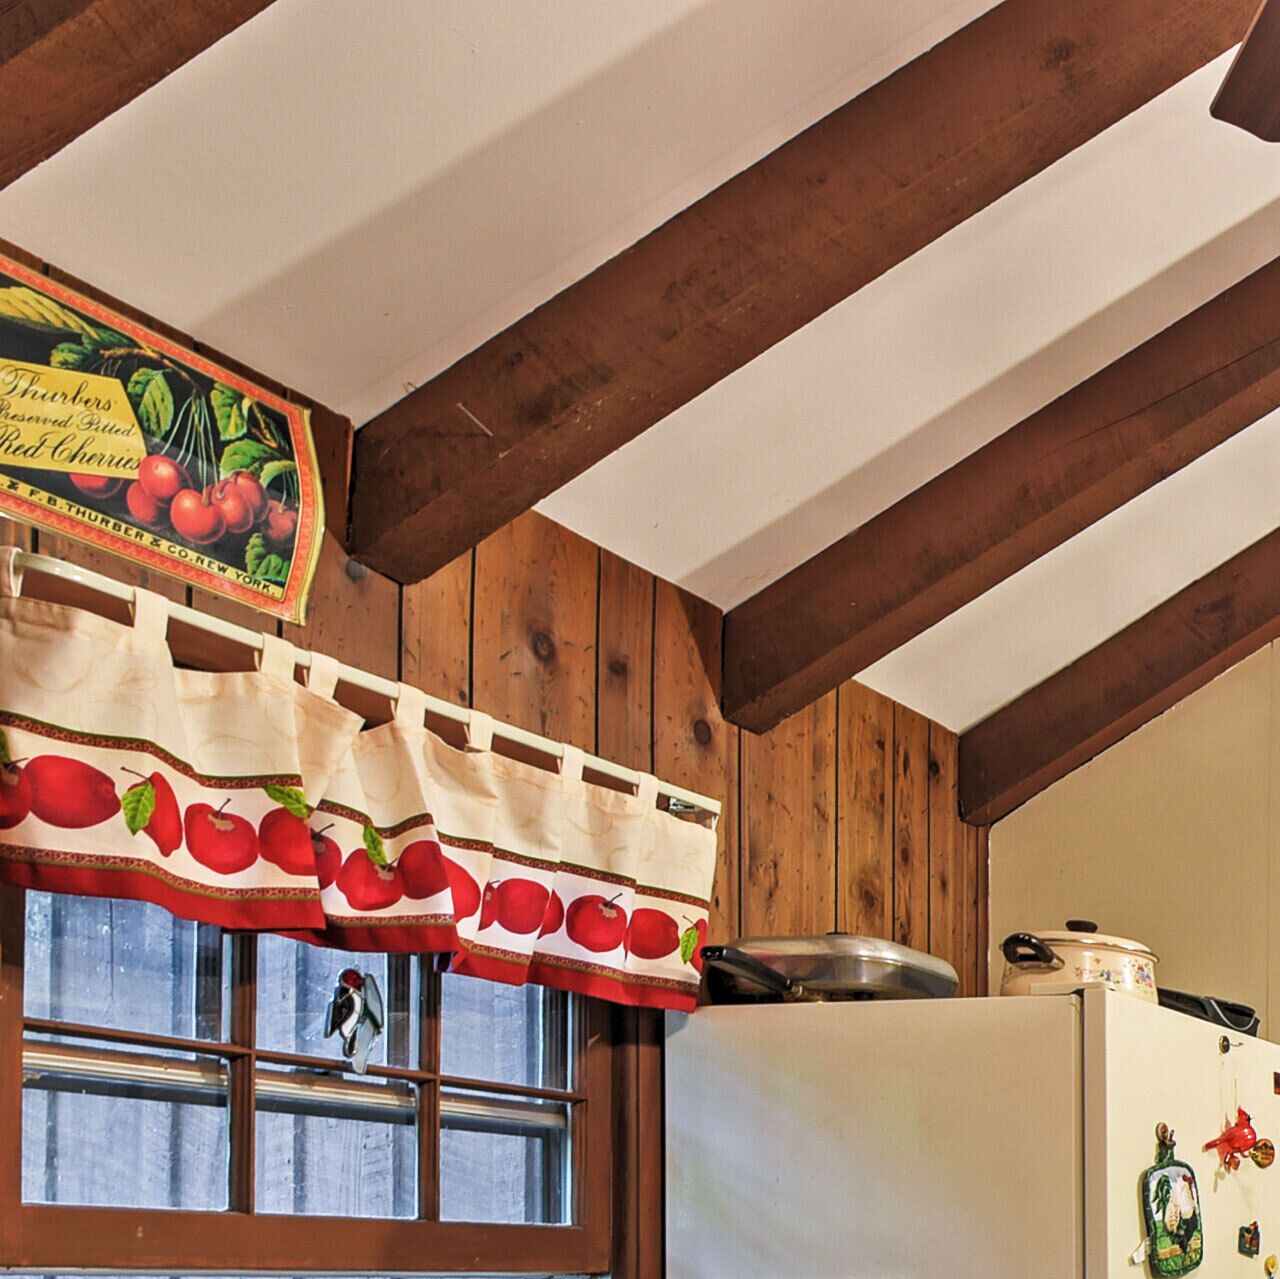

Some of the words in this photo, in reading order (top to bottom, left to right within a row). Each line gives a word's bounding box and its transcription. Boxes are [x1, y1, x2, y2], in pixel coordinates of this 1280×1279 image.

[76, 410, 137, 437] Pitted
[50, 432, 141, 471] Cherries
[150, 538, 161, 548] &
